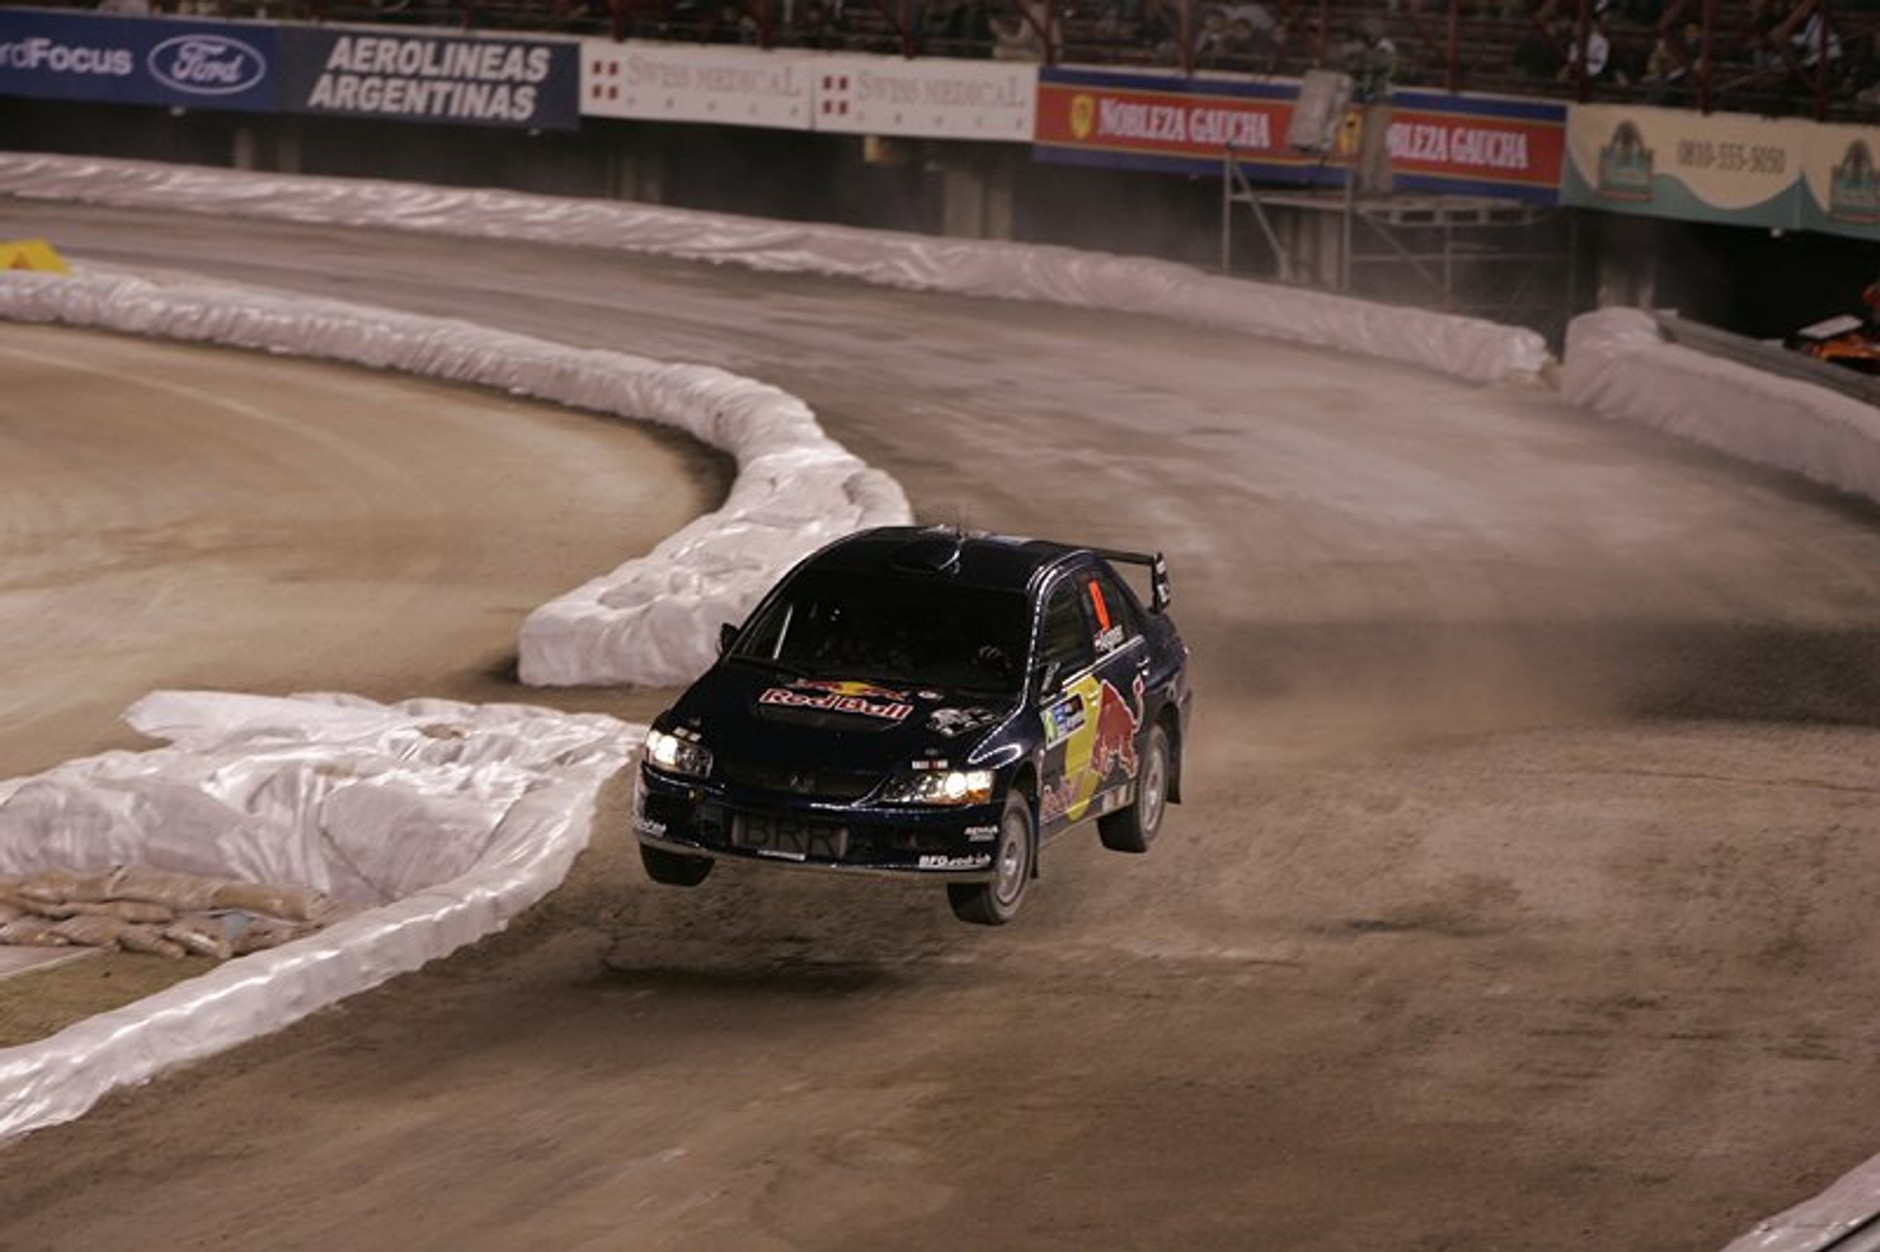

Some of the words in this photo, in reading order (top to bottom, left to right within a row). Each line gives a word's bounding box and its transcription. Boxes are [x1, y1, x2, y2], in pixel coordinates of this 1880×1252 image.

[170, 40, 243, 84] Ford
[326, 36, 551, 82] AEROLINEAS
[307, 73, 538, 120] ARGENTINAS
[1098, 98, 1185, 141] NOBLEZA
[1190, 108, 1270, 148] GAUCHA
[1451, 127, 1528, 169] GAUCHA
[759, 688, 841, 710] Red
[834, 697, 914, 721] Bull
